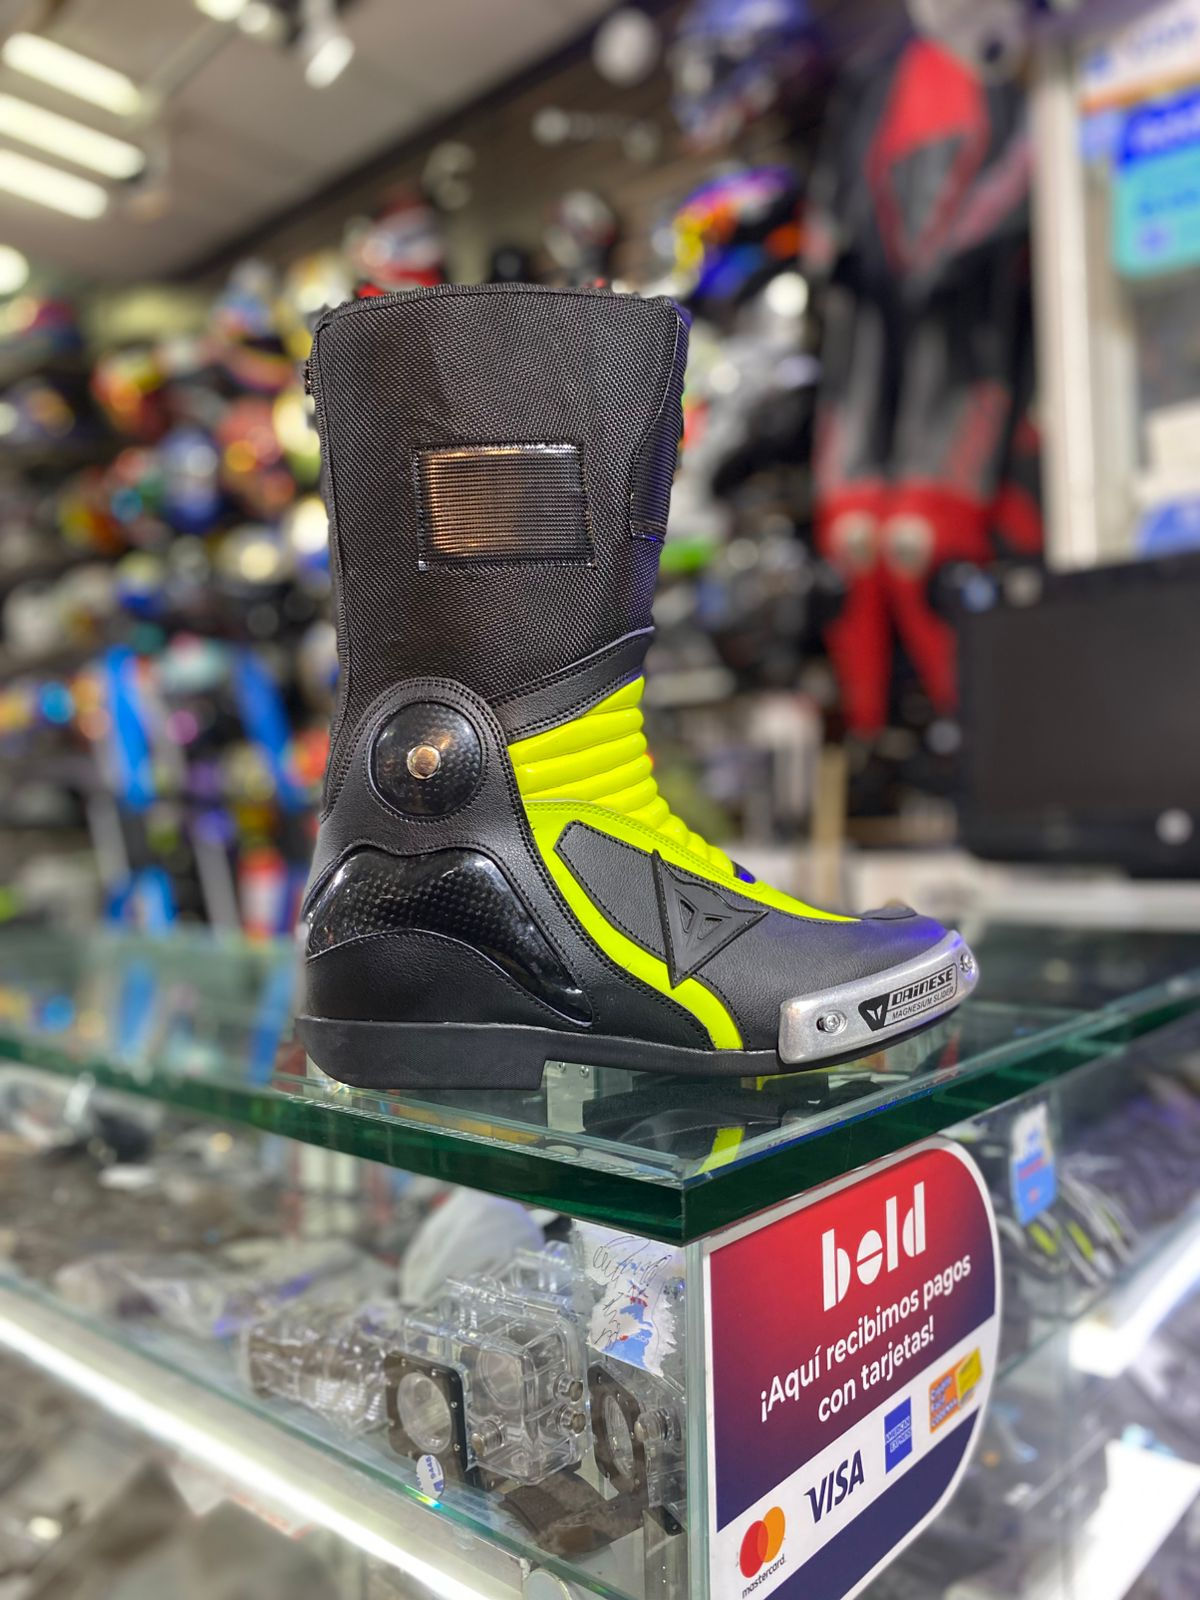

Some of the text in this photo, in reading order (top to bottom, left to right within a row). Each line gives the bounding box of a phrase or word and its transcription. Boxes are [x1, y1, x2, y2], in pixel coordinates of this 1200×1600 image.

[892, 986, 954, 1020] MAGNESIUM SLIDER
[821, 1181, 926, 1312] bold
[760, 1254, 971, 1423] ¡Aquí recibimos pagos
[818, 1378, 856, 1423] con
[861, 1314, 935, 1391] tarjetas!
[803, 1449, 865, 1524] VISA
[741, 1553, 786, 1599] mastercard
